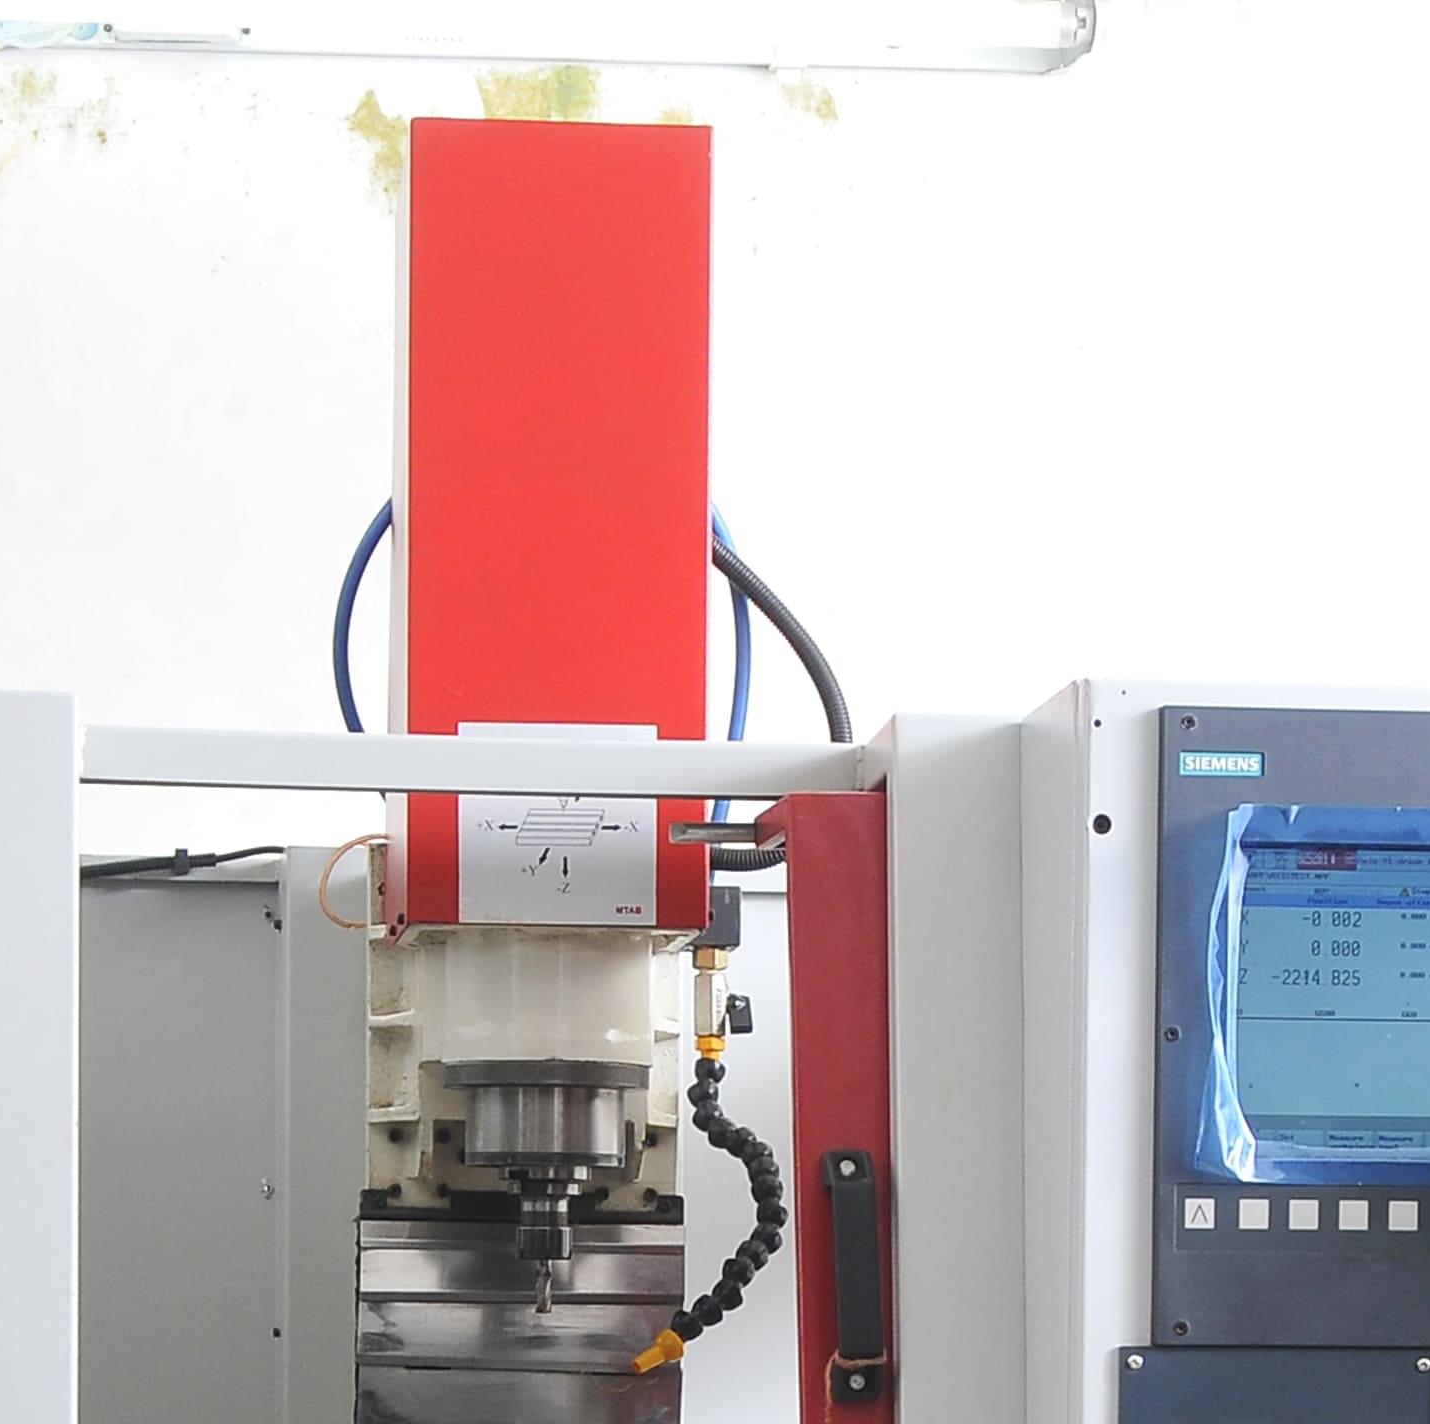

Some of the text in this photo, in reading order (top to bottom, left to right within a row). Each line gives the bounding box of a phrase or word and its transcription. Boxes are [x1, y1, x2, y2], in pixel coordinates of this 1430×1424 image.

[1186, 757, 1258, 770] SIEMENS
[615, 906, 642, 915] MTAB
[1303, 911, 1361, 927] -0.002
[1312, 940, 1360, 956] 0.000
[1273, 969, 1360, 986] -2214.825
